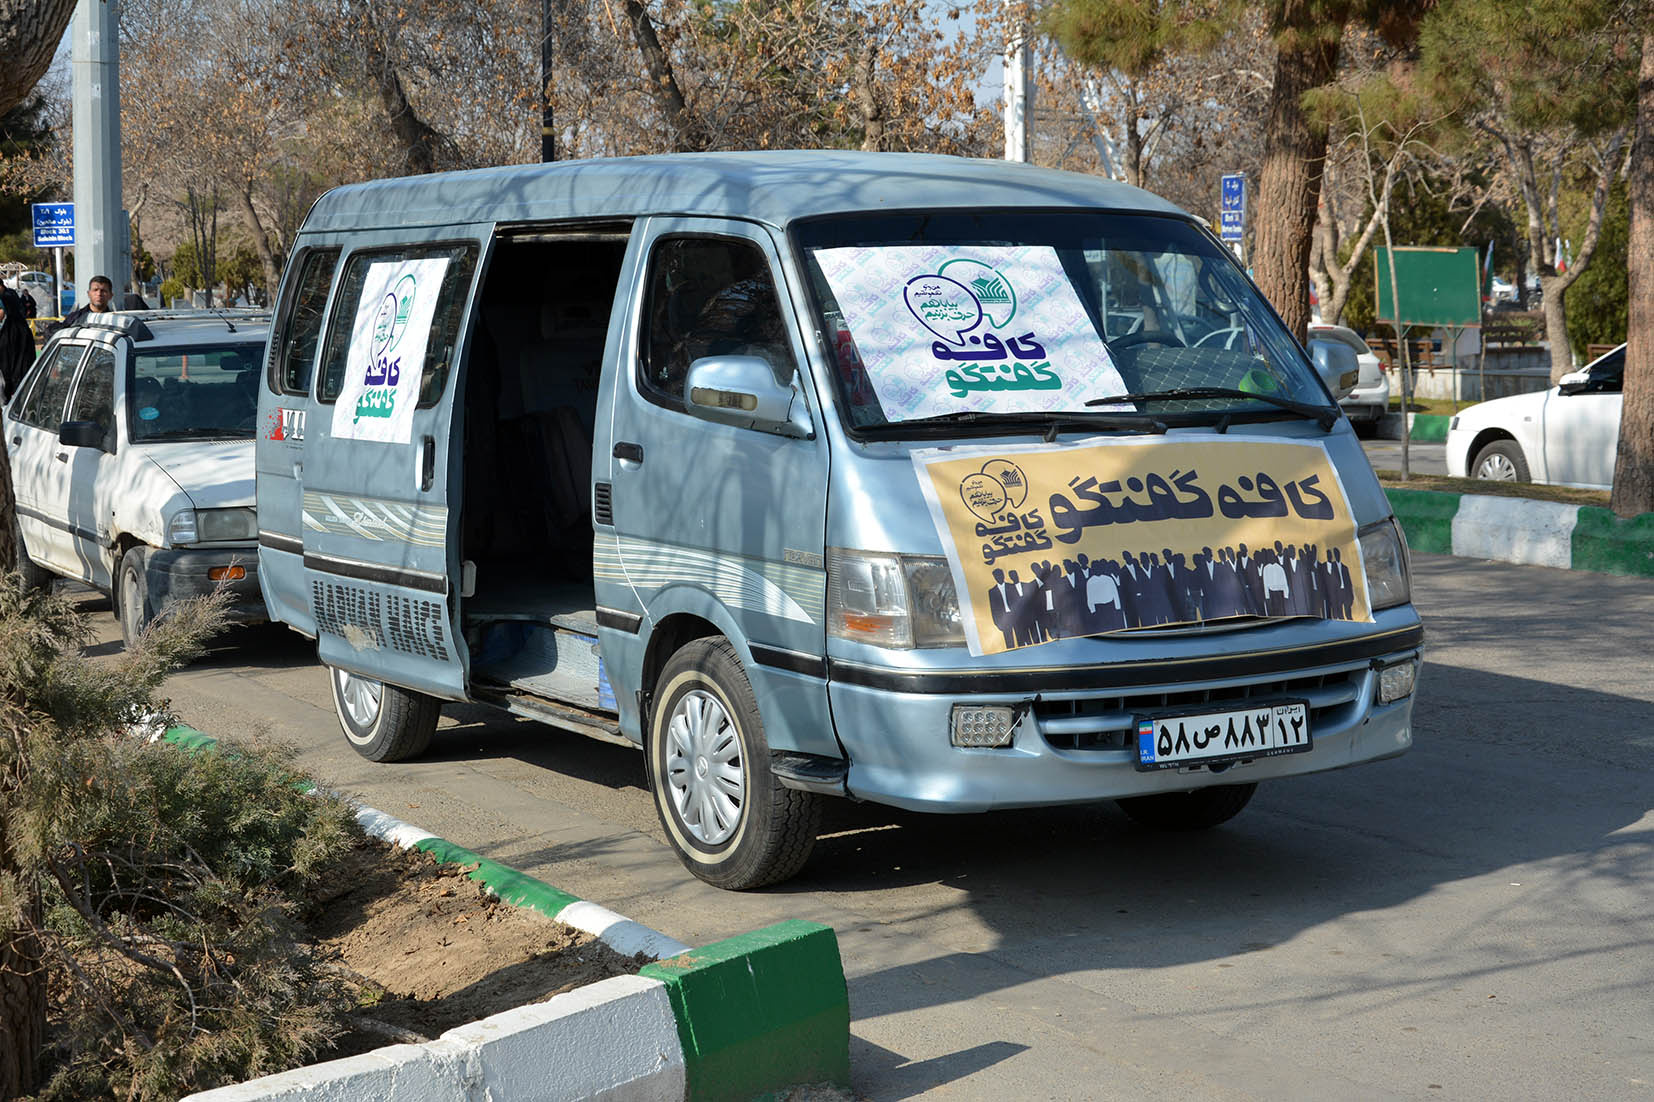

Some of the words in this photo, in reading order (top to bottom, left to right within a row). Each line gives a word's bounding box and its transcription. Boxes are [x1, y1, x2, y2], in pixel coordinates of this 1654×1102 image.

[931, 331, 1046, 361] کافه
[364, 356, 401, 387] کافه
[945, 361, 1062, 398] گفتگو
[352, 388, 397, 425] گفتگو
[1048, 469, 1214, 544] گفتگو
[1218, 472, 1334, 521] کافه
[975, 508, 1044, 537] کافه
[982, 528, 1053, 565] گفتگو
[1276, 706, 1301, 716] ایران
